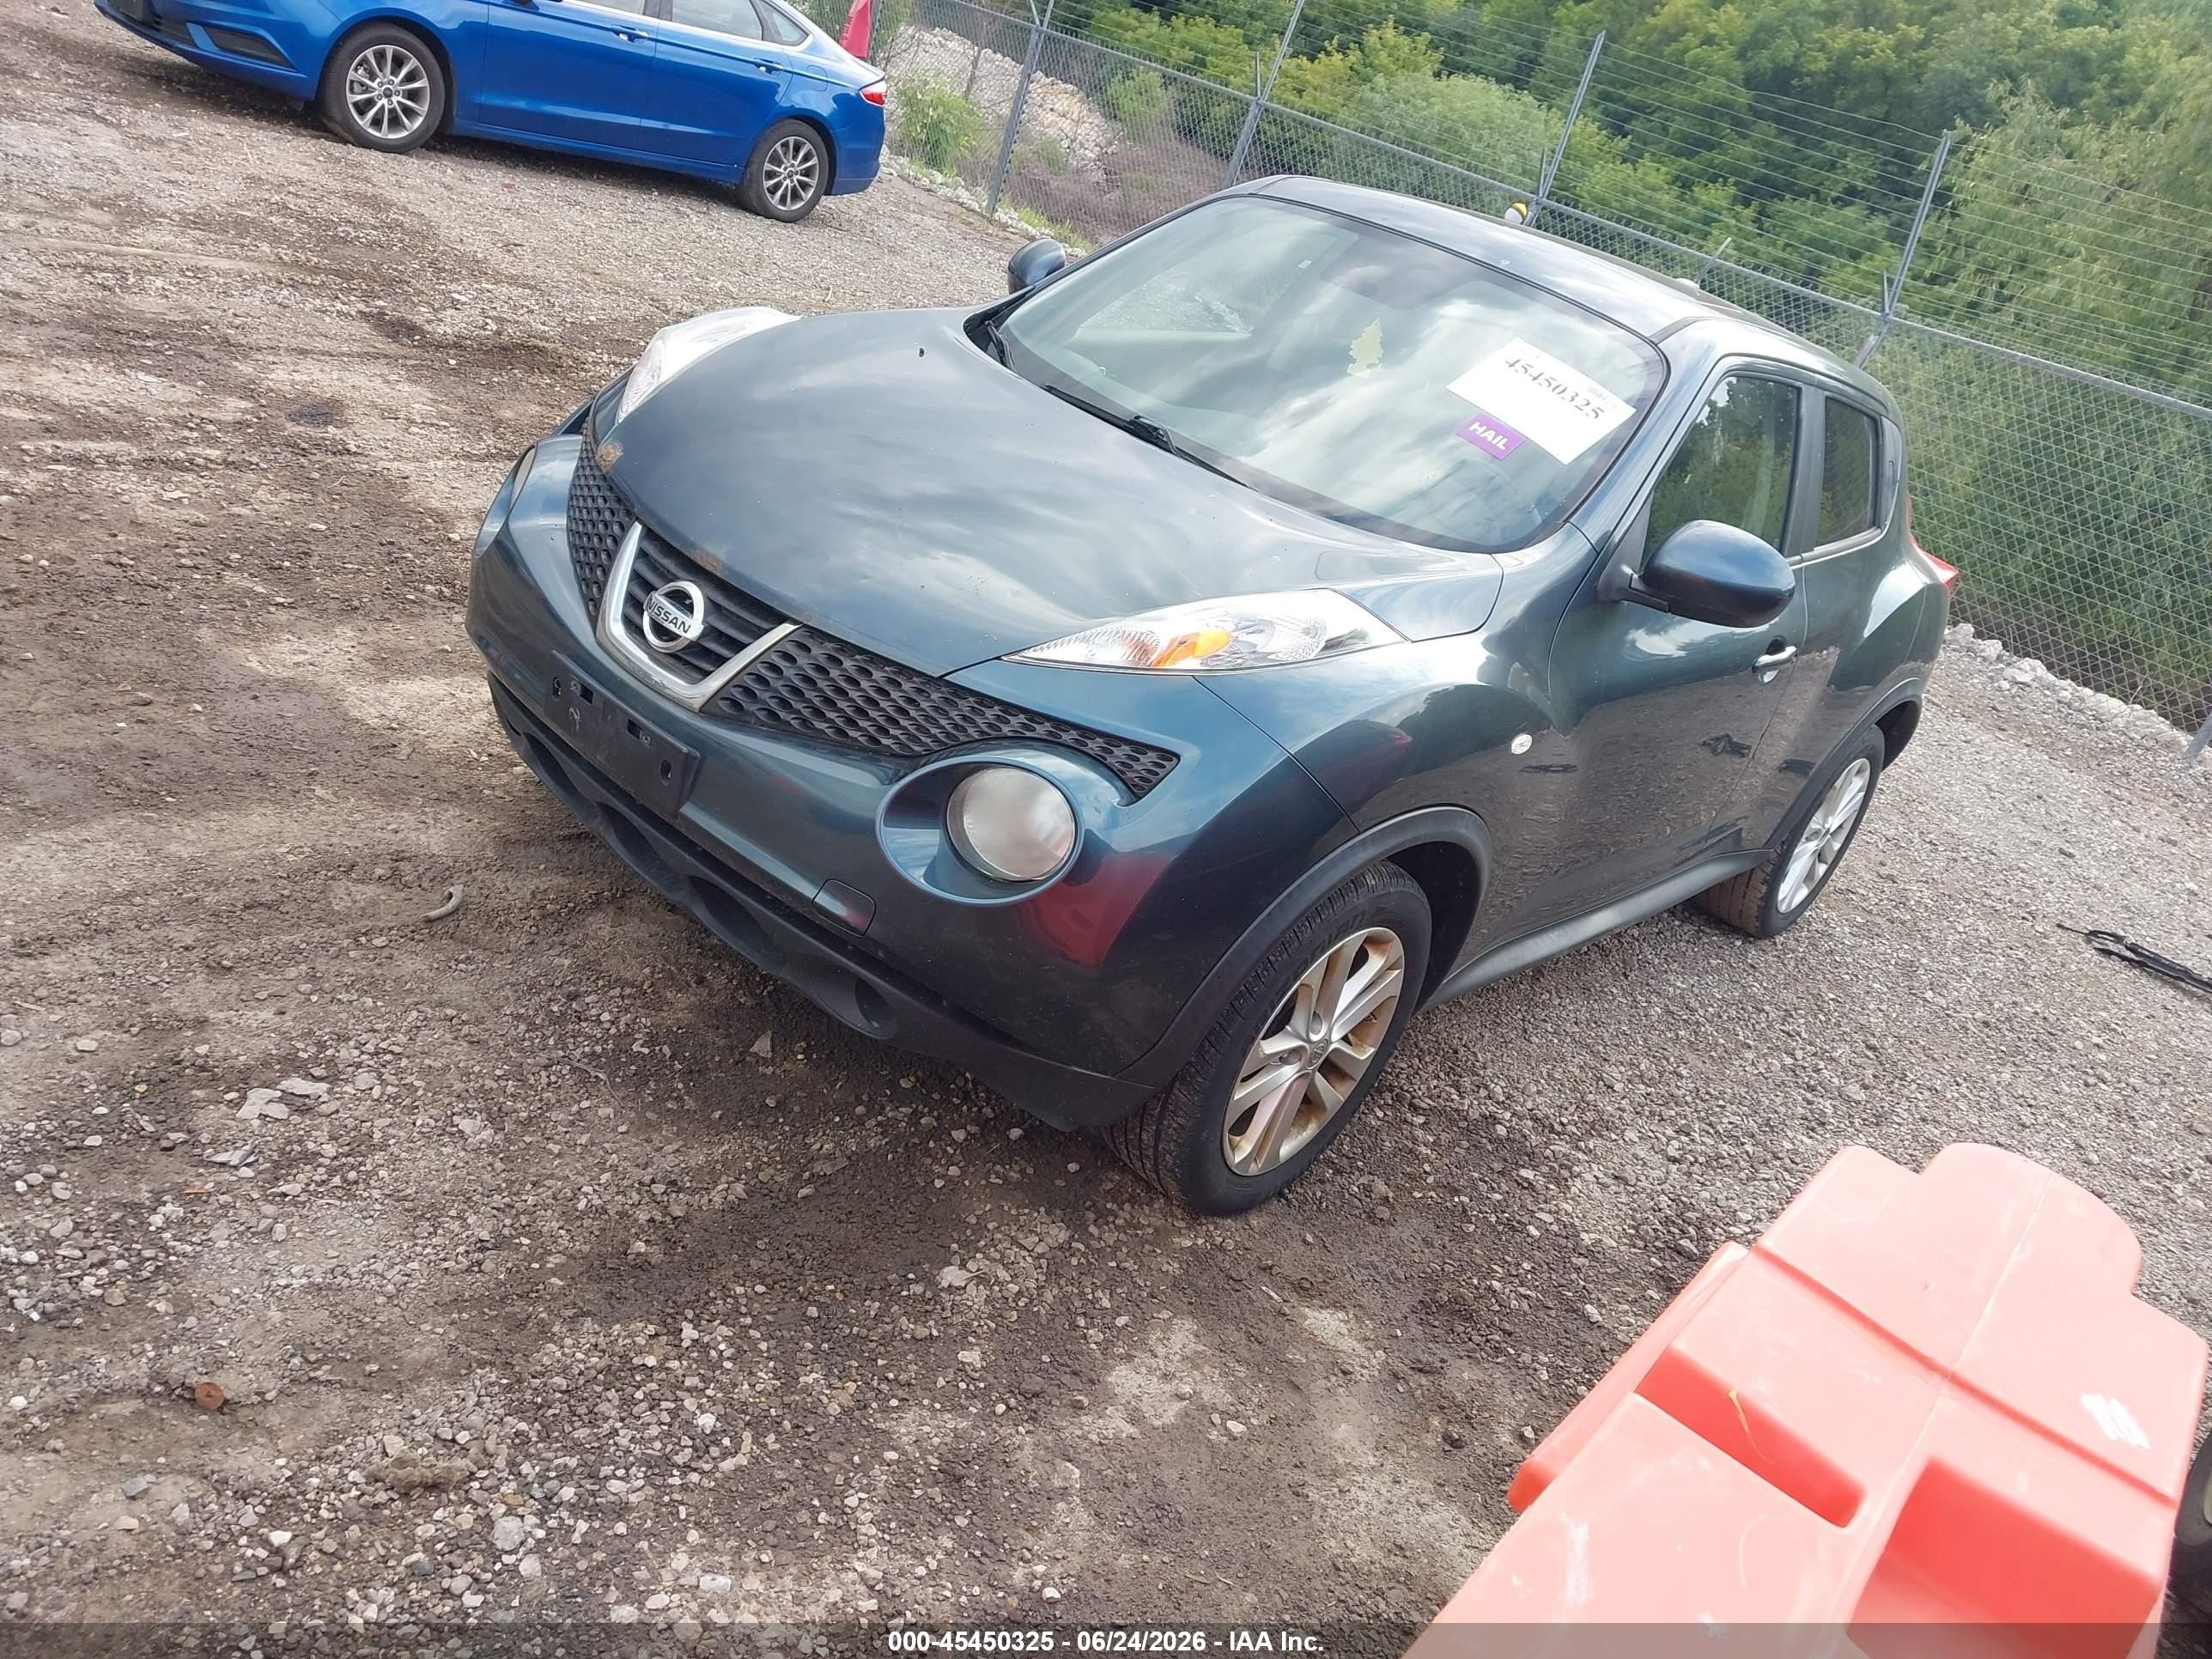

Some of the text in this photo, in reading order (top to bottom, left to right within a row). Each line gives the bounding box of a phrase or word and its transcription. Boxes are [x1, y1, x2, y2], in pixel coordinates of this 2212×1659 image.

[1504, 358, 1606, 420] 45450325
[1468, 420, 1510, 450] HAIL
[646, 598, 691, 634] NISSAN
